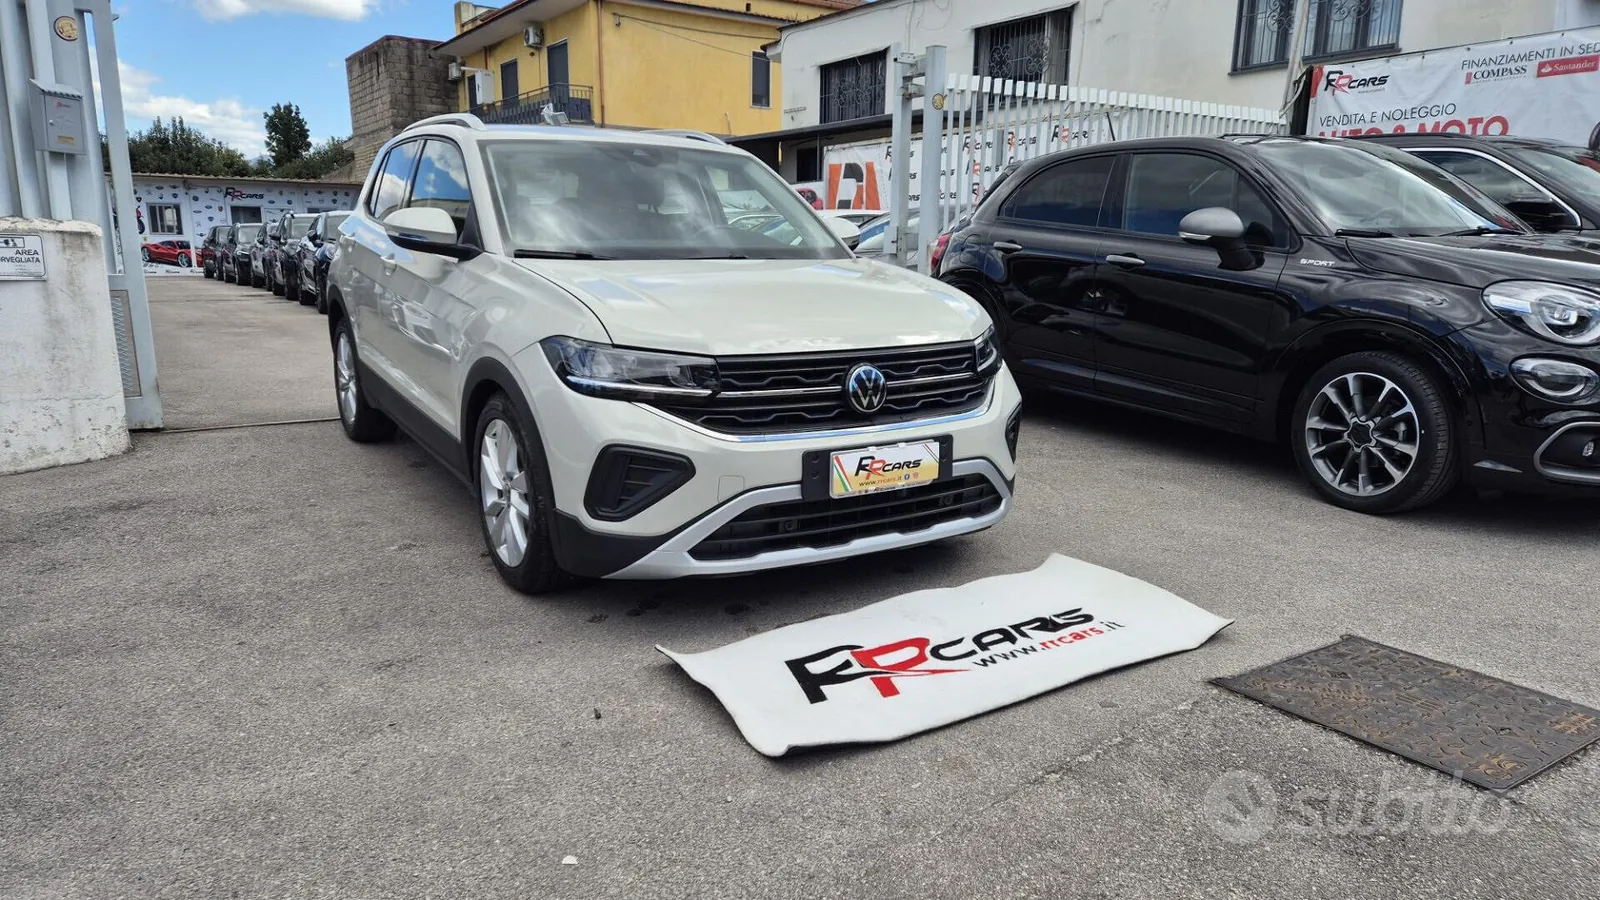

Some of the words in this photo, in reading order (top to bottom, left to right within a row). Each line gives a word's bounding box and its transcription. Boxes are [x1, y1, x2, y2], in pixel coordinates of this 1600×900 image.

[1461, 48, 1555, 70] FINANZIAMENTI
[1560, 45, 1574, 57] IN
[1554, 60, 1596, 72] Santander
[1473, 65, 1528, 80] COMPASS
[1320, 113, 1366, 127] VENDITA
[1370, 111, 1377, 123] E
[1381, 103, 1456, 122] NOLEGGIO
[1300, 258, 1335, 267] SPORT
[972, 620, 1126, 668] www.rrcars.it
